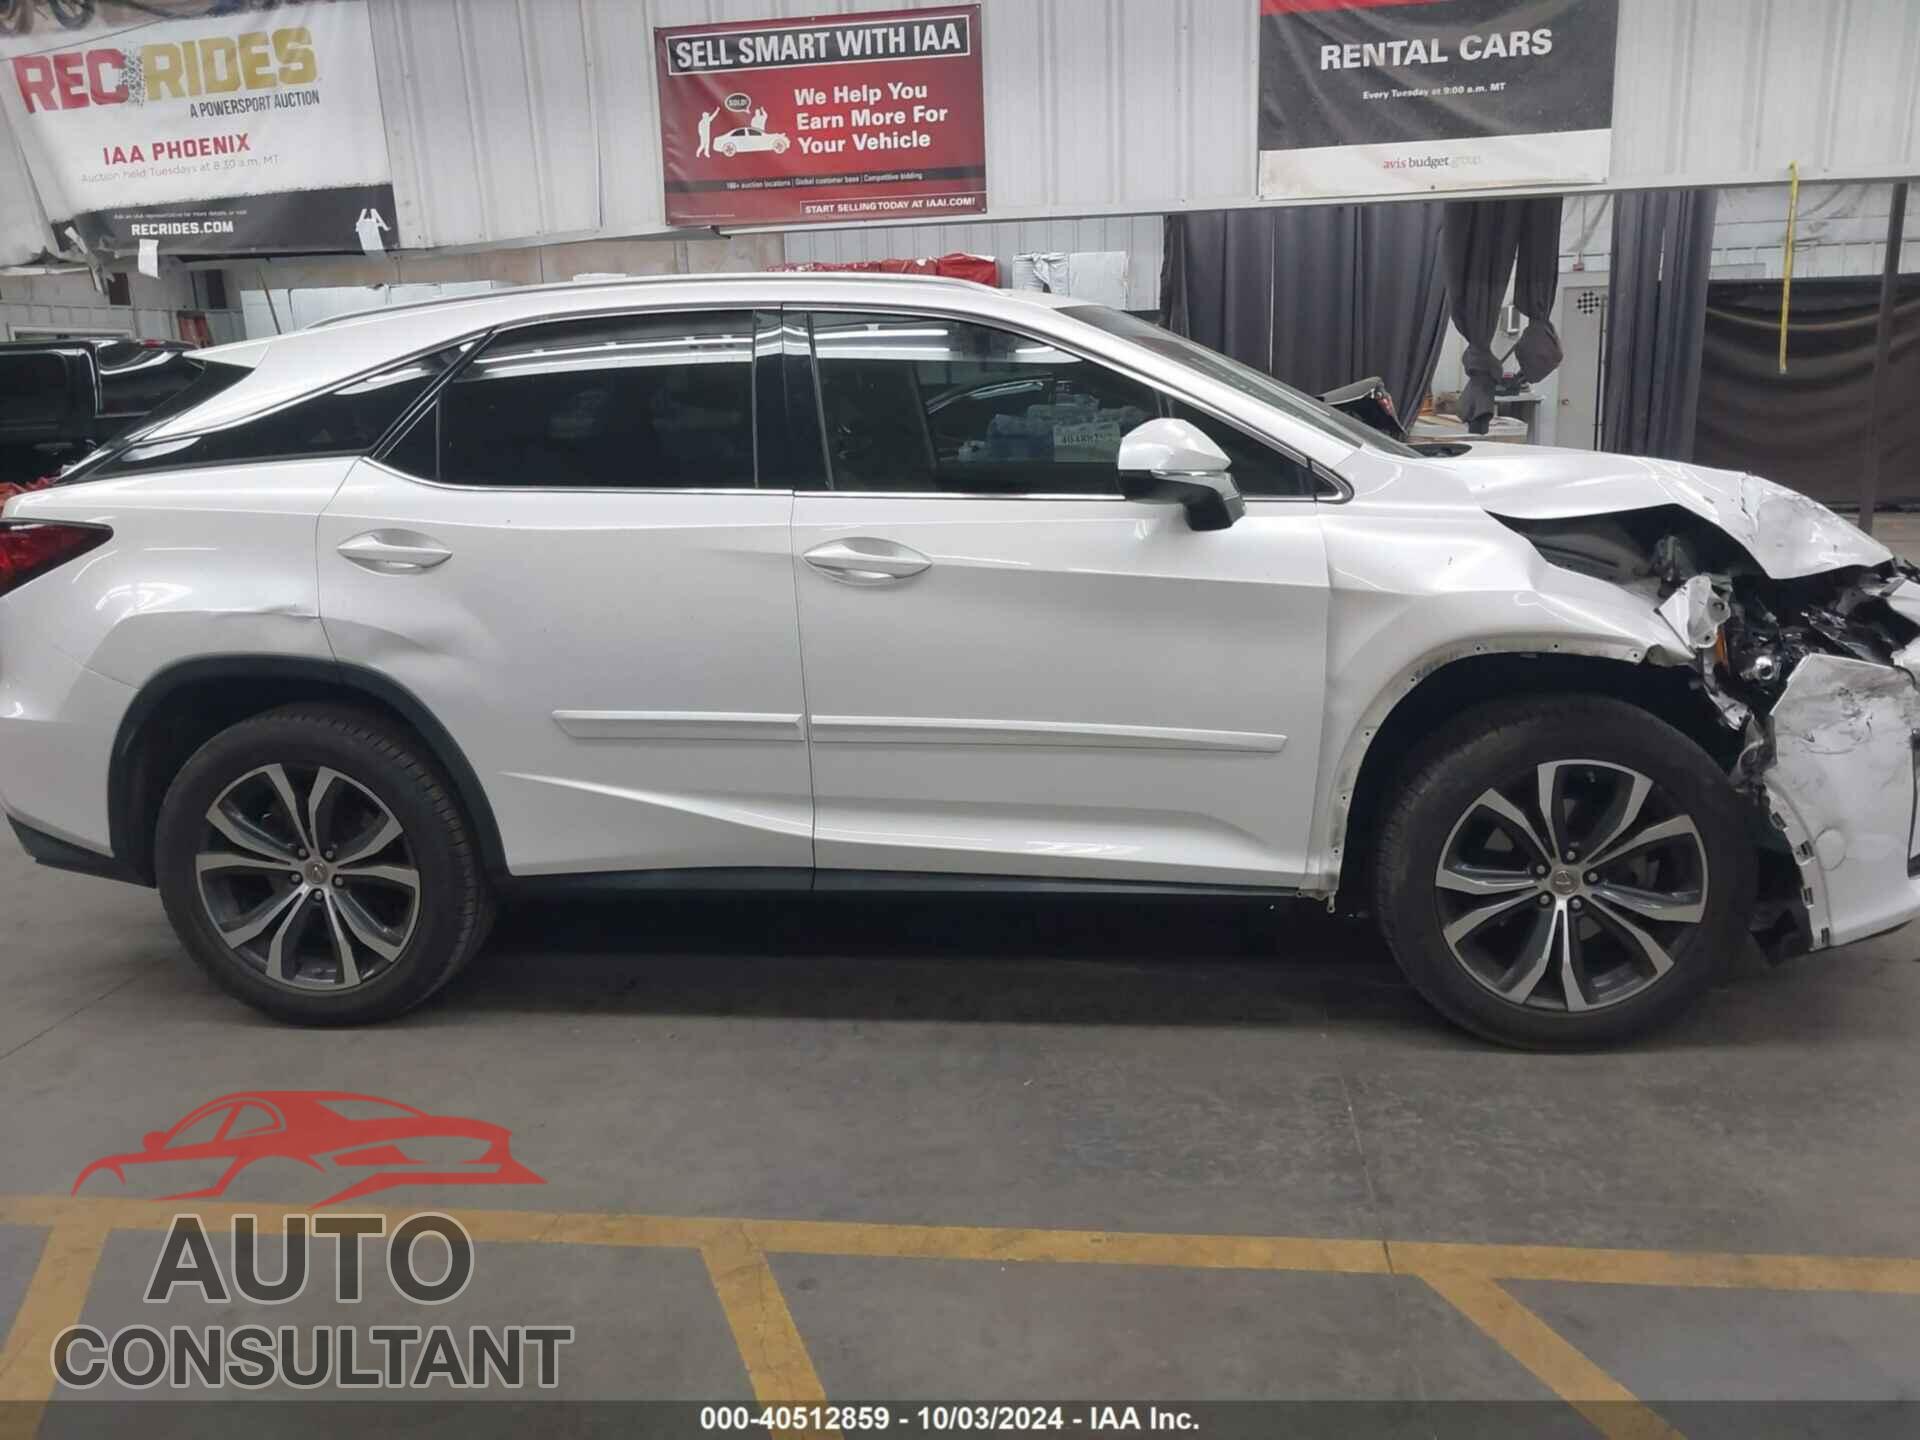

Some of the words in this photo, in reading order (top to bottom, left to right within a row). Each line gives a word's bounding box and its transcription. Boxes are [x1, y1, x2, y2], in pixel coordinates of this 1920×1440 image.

[676, 40, 733, 68] SELL
[739, 32, 830, 63] SMART
[835, 26, 906, 57] WITH
[913, 22, 961, 52] IAA
[1320, 37, 1448, 70] RENTAL
[1459, 28, 1553, 62] CARS
[141, 26, 319, 101] RIDES
[190, 103, 199, 119] A
[199, 95, 272, 117] POWERSPORT
[274, 88, 320, 109] AUCTION
[794, 88, 827, 106] We
[833, 84, 882, 105] Help
[888, 81, 928, 100] You
[1362, 91, 1389, 100] Every
[1391, 87, 1429, 97] Tuesday
[1443, 86, 1464, 95] 9:00
[1490, 82, 1506, 92] MT
[796, 112, 844, 130] Earn
[851, 109, 906, 127] More
[913, 105, 948, 123] For
[103, 145, 146, 166] IAA
[152, 133, 250, 161] PHOENIX
[798, 136, 846, 154] Your
[852, 130, 931, 151] Vehicle
[150, 163, 198, 177] Tuesdays
[1383, 157, 1407, 169] avis
[1408, 155, 1449, 169] budget
[805, 204, 834, 214] START
[837, 202, 878, 213] SELLING
[878, 200, 909, 210] TODAY
[912, 199, 924, 208] AT
[131, 220, 234, 236] RECRIDES.COM
